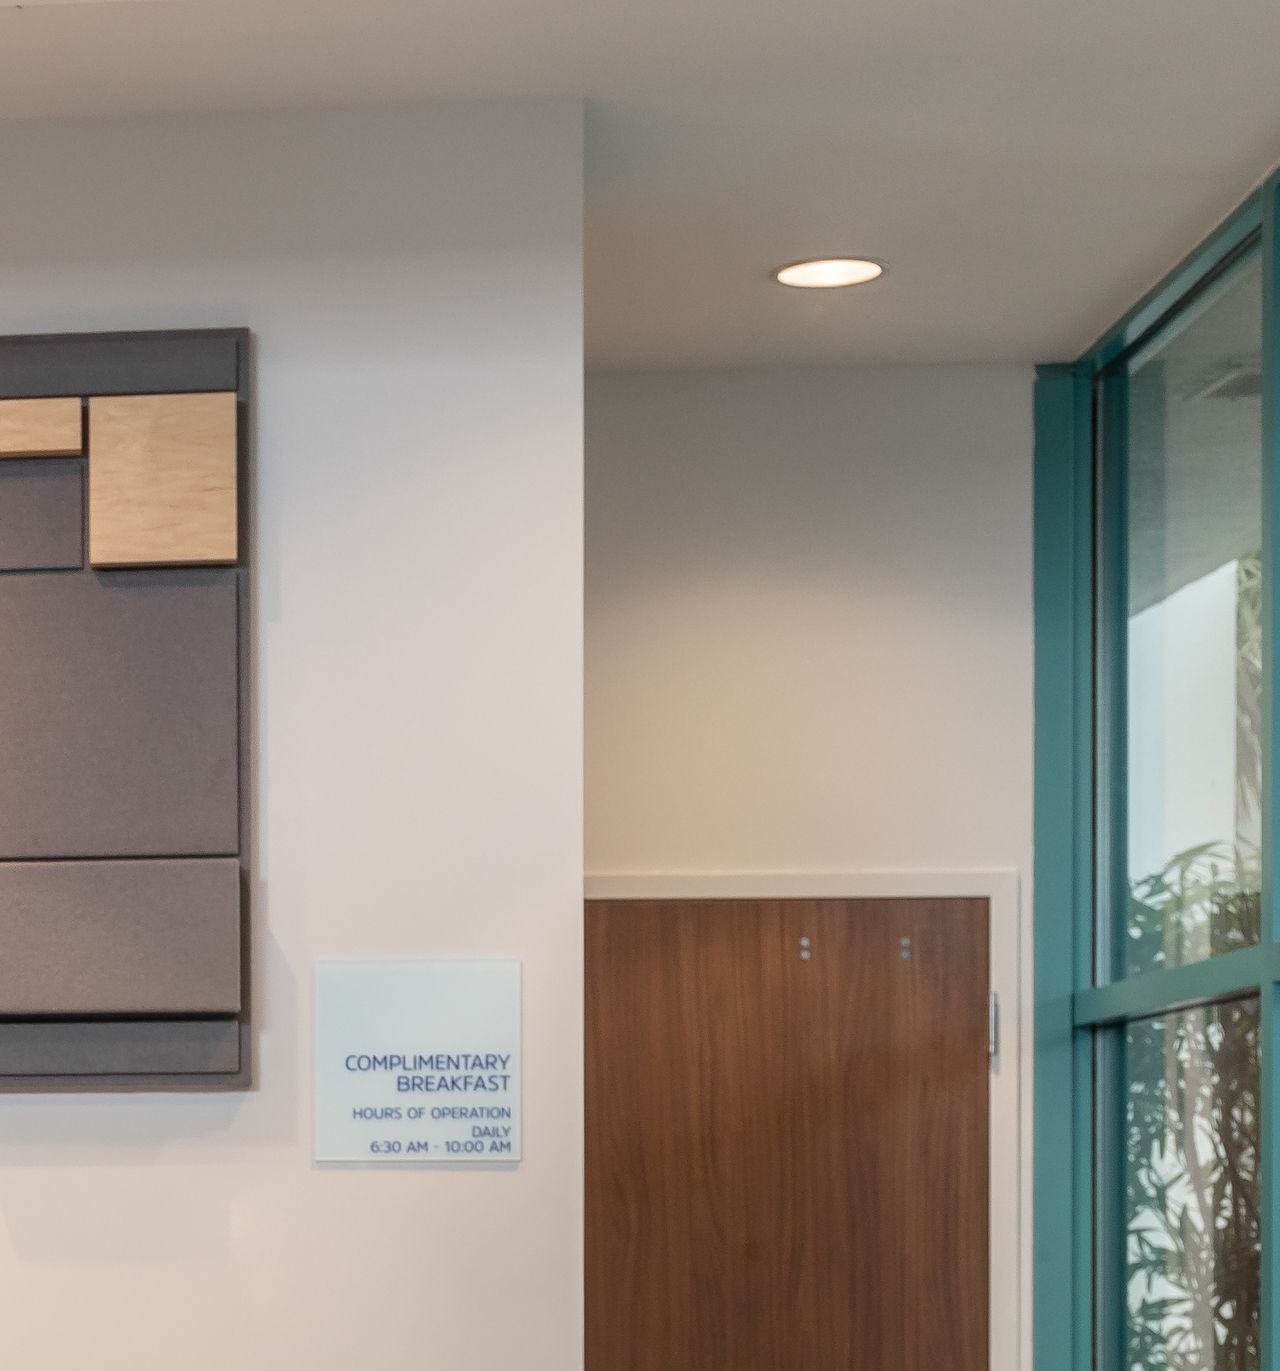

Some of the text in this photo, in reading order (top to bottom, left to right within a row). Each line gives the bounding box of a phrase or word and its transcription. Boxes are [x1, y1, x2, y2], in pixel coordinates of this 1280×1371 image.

[345, 1054, 512, 1072] COMPLIMENTARY
[396, 1074, 512, 1093] BREAKFAST
[352, 1106, 512, 1120] HOURS OF OPERATION
[471, 1125, 512, 1139] DAILY
[370, 1140, 403, 1154] 6:30
[406, 1140, 430, 1153] AM
[445, 1140, 486, 1153] 10:00
[489, 1140, 512, 1153] AM
